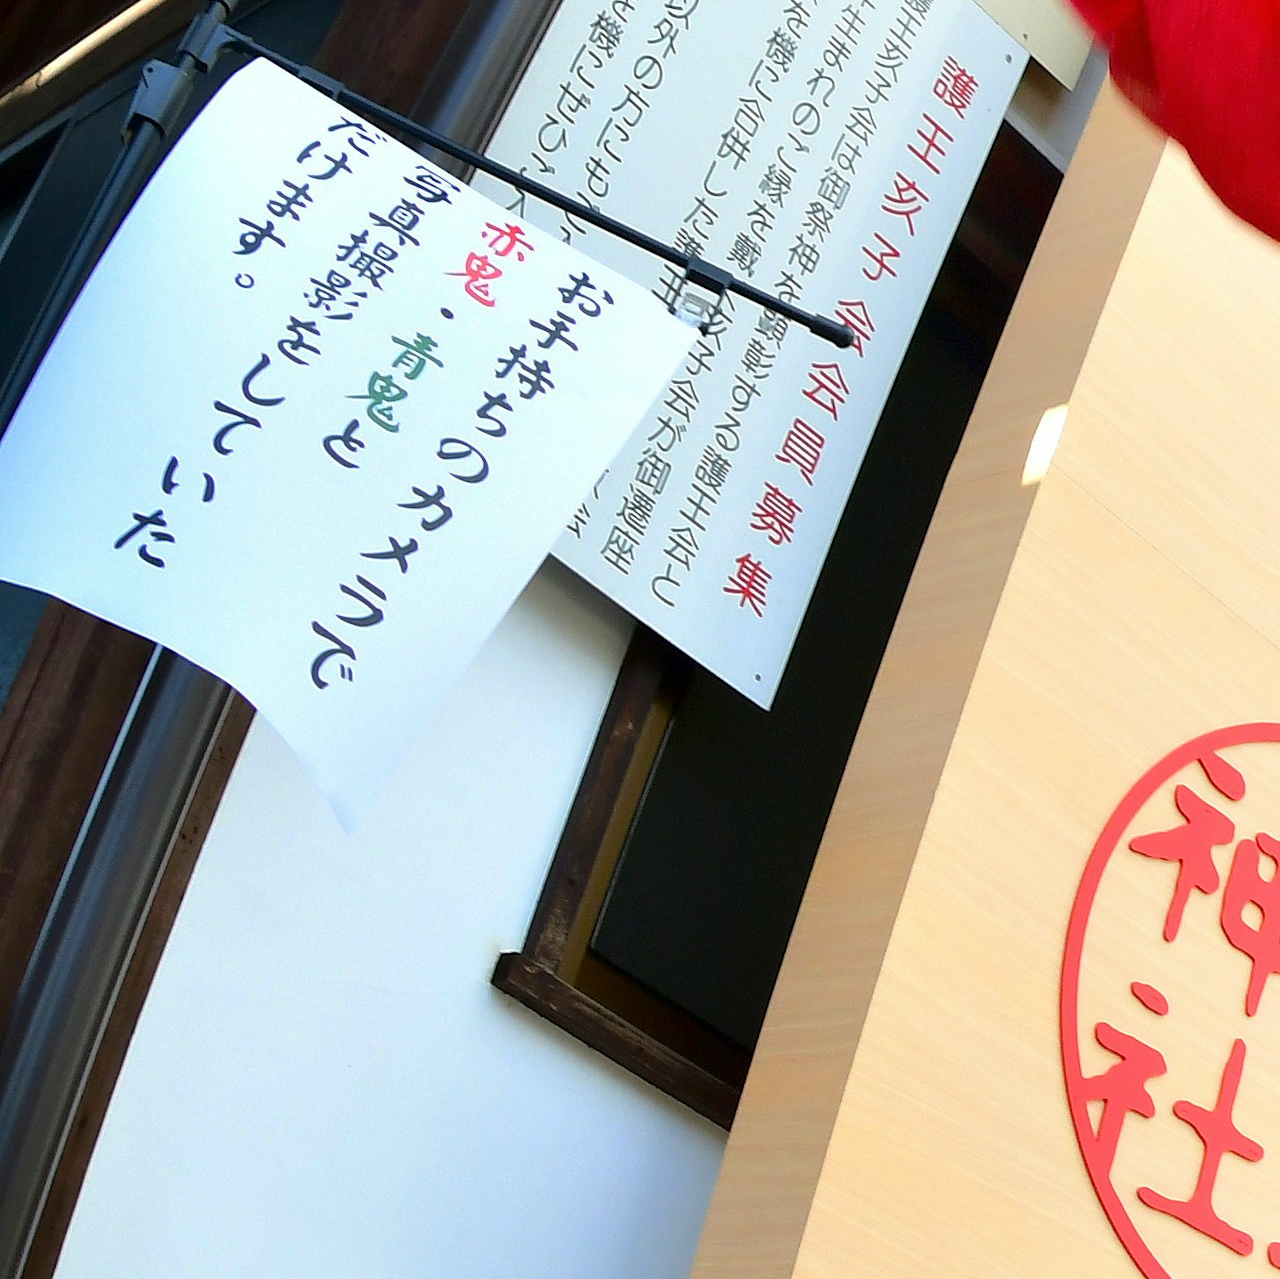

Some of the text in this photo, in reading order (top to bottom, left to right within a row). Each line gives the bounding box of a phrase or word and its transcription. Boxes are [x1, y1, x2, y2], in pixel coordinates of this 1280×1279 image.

[114, 165, 471, 568] 写真撮影をしていた
[232, 116, 388, 290] だけます。
[322, 222, 535, 469] 赤鬼・青鬼と
[723, 55, 979, 618] 護王亥子会会員募集
[310, 272, 615, 690] お手持ちのカメラで
